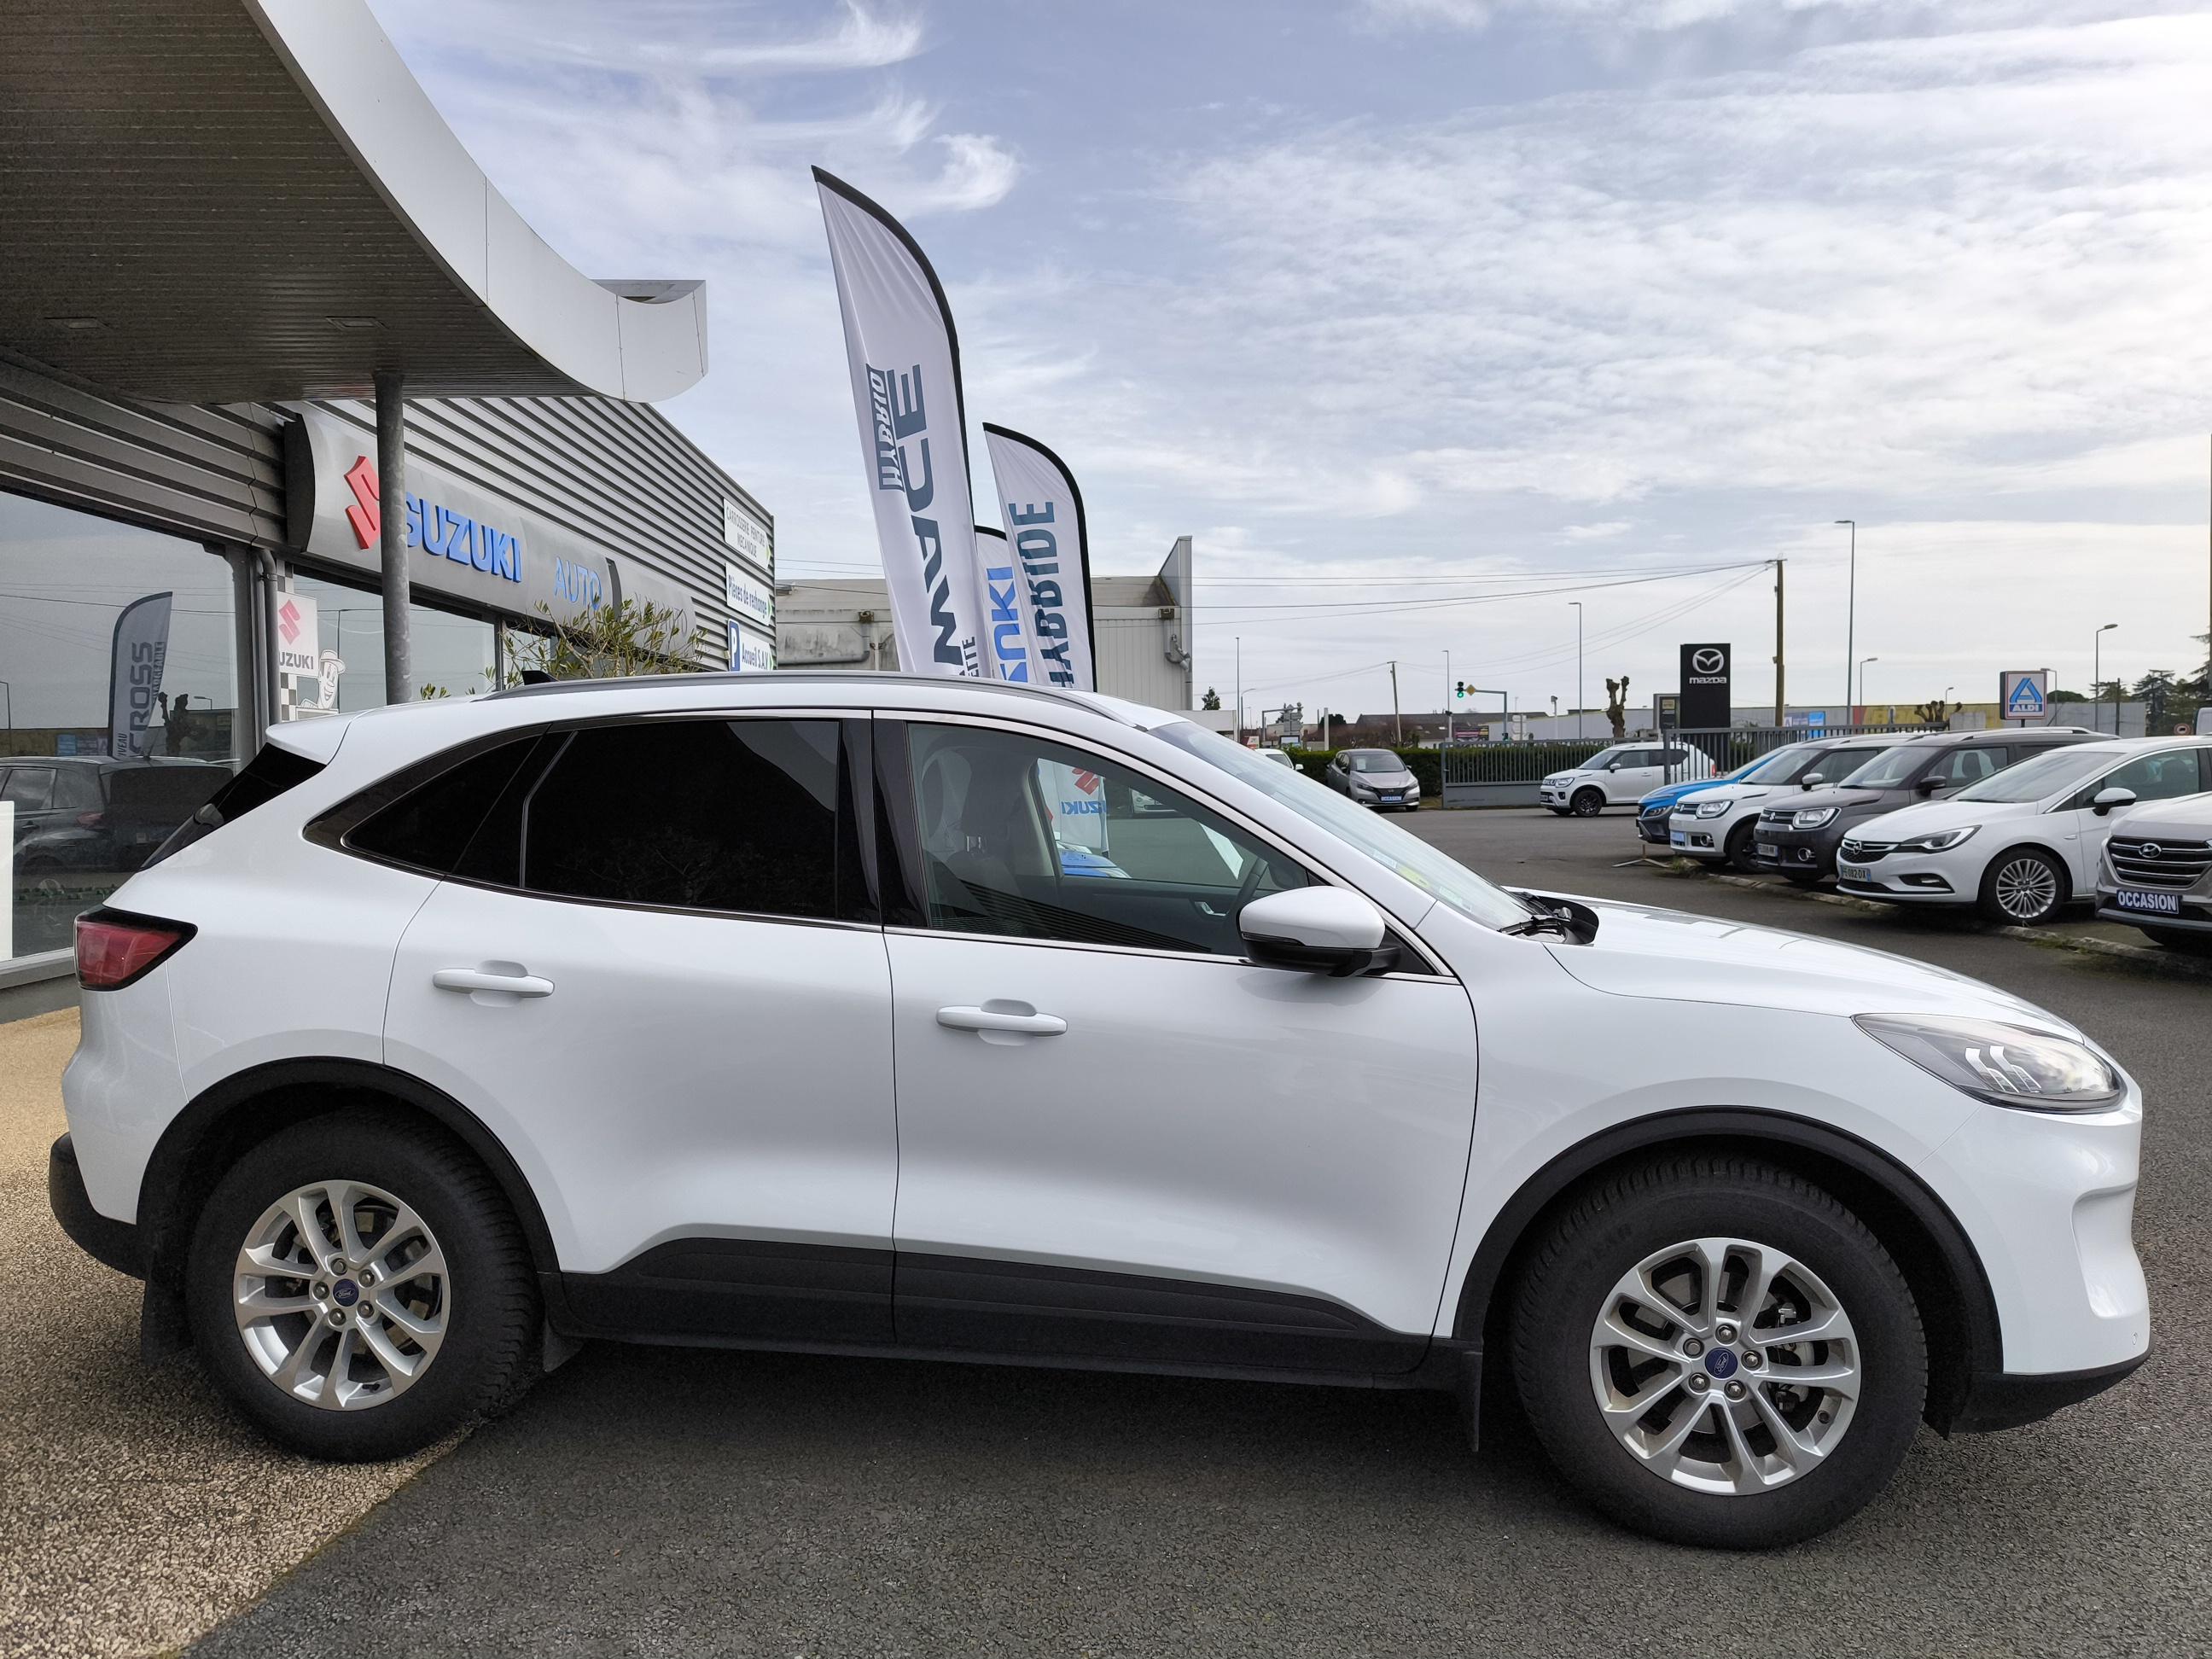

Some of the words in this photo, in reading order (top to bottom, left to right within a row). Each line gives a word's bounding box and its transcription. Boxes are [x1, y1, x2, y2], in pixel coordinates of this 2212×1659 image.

[406, 492, 521, 584] SUZUKI
[555, 556, 602, 611] AUTO
[731, 626, 737, 668] P
[130, 641, 154, 755] CROSS
[2012, 703, 2040, 713] ALDI
[2117, 890, 2177, 911] OCCASION
